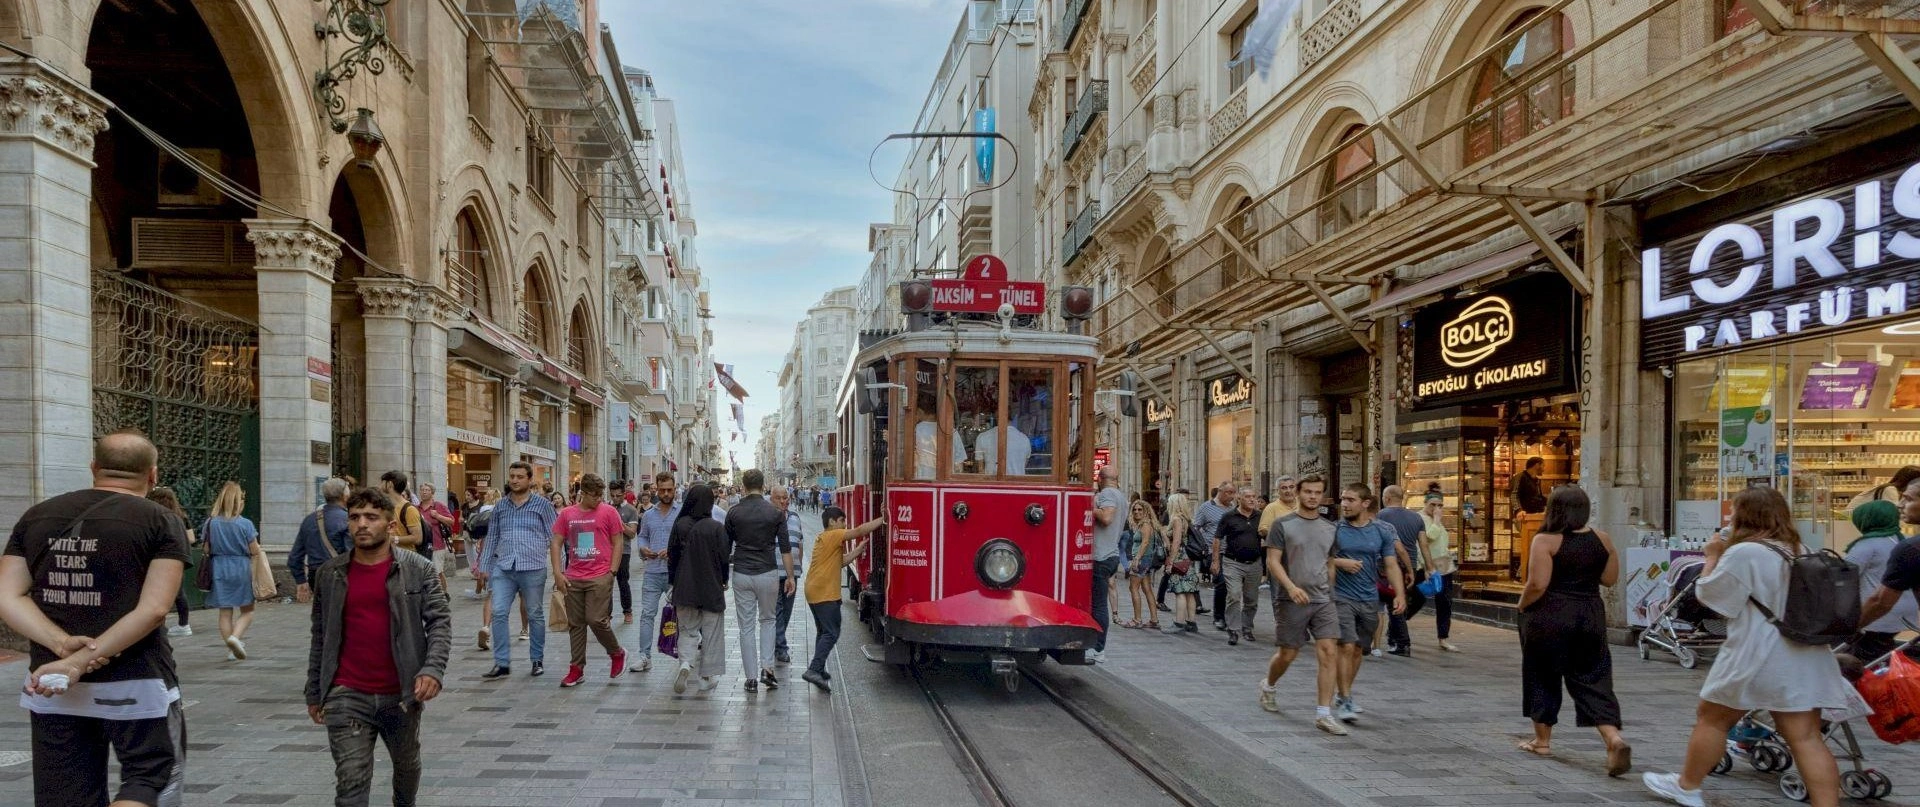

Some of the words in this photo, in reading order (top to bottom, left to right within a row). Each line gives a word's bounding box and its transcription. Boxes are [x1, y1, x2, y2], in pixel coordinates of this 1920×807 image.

[980, 257, 991, 278] 2
[932, 284, 974, 305] TAKSİM
[999, 285, 1038, 307] TÜNEL
[1684, 282, 1907, 352] PARFÜM
[1418, 374, 1467, 397] BEYOĞLU
[1474, 358, 1546, 389] ÇİKOLATASI
[1212, 378, 1250, 406] Bambi
[897, 505, 912, 522] 223
[80, 538, 98, 552] THE
[910, 549, 927, 557] YASAK
[54, 554, 87, 569] TEARS
[48, 572, 69, 587] RUN
[71, 573, 94, 588] INTO
[42, 588, 67, 605] YOUR
[69, 590, 101, 607] MOUTH
